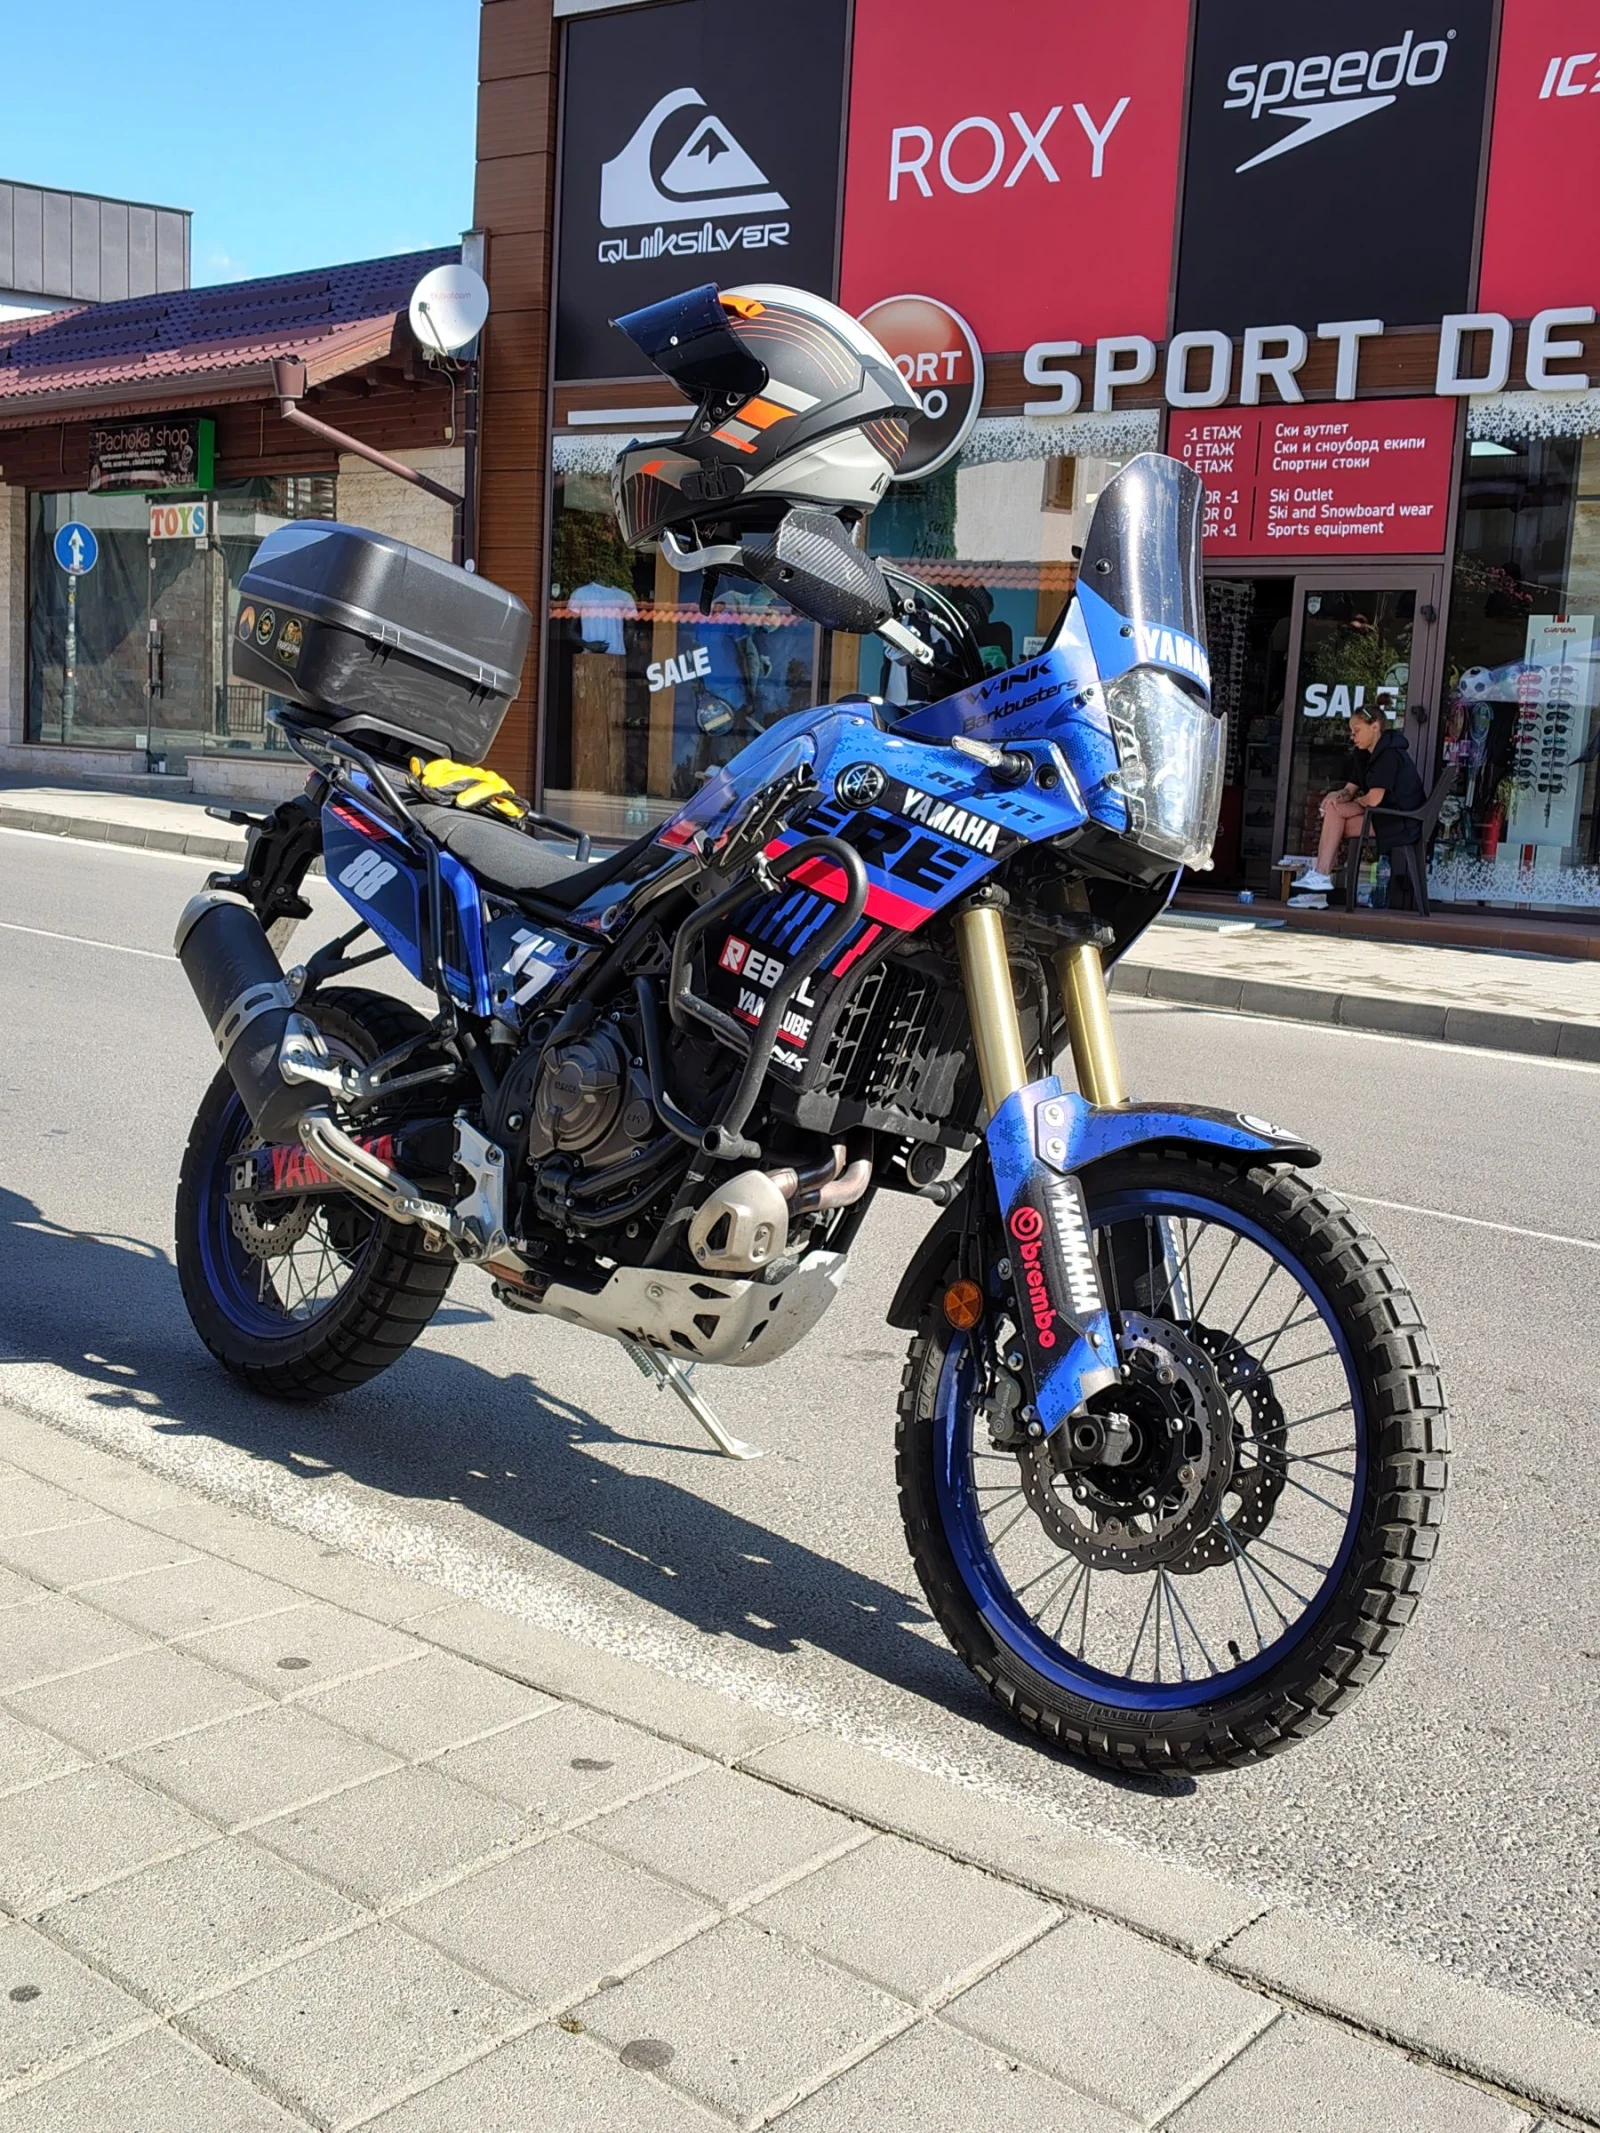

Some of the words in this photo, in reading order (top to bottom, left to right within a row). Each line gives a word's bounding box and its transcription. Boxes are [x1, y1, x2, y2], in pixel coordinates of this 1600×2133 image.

[1223, 30, 1448, 119] speedo
[889, 97, 1131, 201] ROXY
[598, 221, 790, 264] QUIKSILVER
[893, 350, 963, 383] ORT
[1023, 319, 1384, 416] SPORT
[1436, 306, 1597, 395] DE
[156, 425, 190, 449] shop
[1185, 428, 1198, 441] -1
[1203, 425, 1242, 440] ЕТАЖ
[1274, 441, 1297, 455] Ски
[1302, 442, 1311, 452] и
[1315, 438, 1380, 455] сноуборд
[1384, 437, 1426, 450] екипи
[1275, 423, 1299, 437] Ски
[1303, 422, 1349, 438] аутлет
[1183, 444, 1191, 457] 0
[1196, 443, 1235, 457] ЕТАЖ
[1194, 459, 1234, 473] ЕТАЖ
[1272, 456, 1328, 473] Спортни
[1332, 457, 1370, 470] стоки
[1225, 491, 1239, 504] -1
[1270, 488, 1290, 503] Ski
[1294, 487, 1334, 502] Outlet
[152, 505, 205, 537] TOYS
[1268, 506, 1288, 520] Ski
[1292, 504, 1317, 518] and
[1320, 503, 1395, 519] Snowboard
[1399, 504, 1434, 517] wear
[1223, 523, 1238, 537] +1
[1267, 522, 1310, 539] Sports
[1314, 521, 1384, 538] equipment
[646, 646, 712, 693] SALE
[963, 679, 1078, 733] Barkbusters
[901, 788, 1000, 854] YAMAHA
[339, 849, 397, 900] 88
[722, 938, 815, 1008] REBL
[1052, 1193, 1102, 1314] YAMAHA
[1020, 1241, 1057, 1348] brembo
